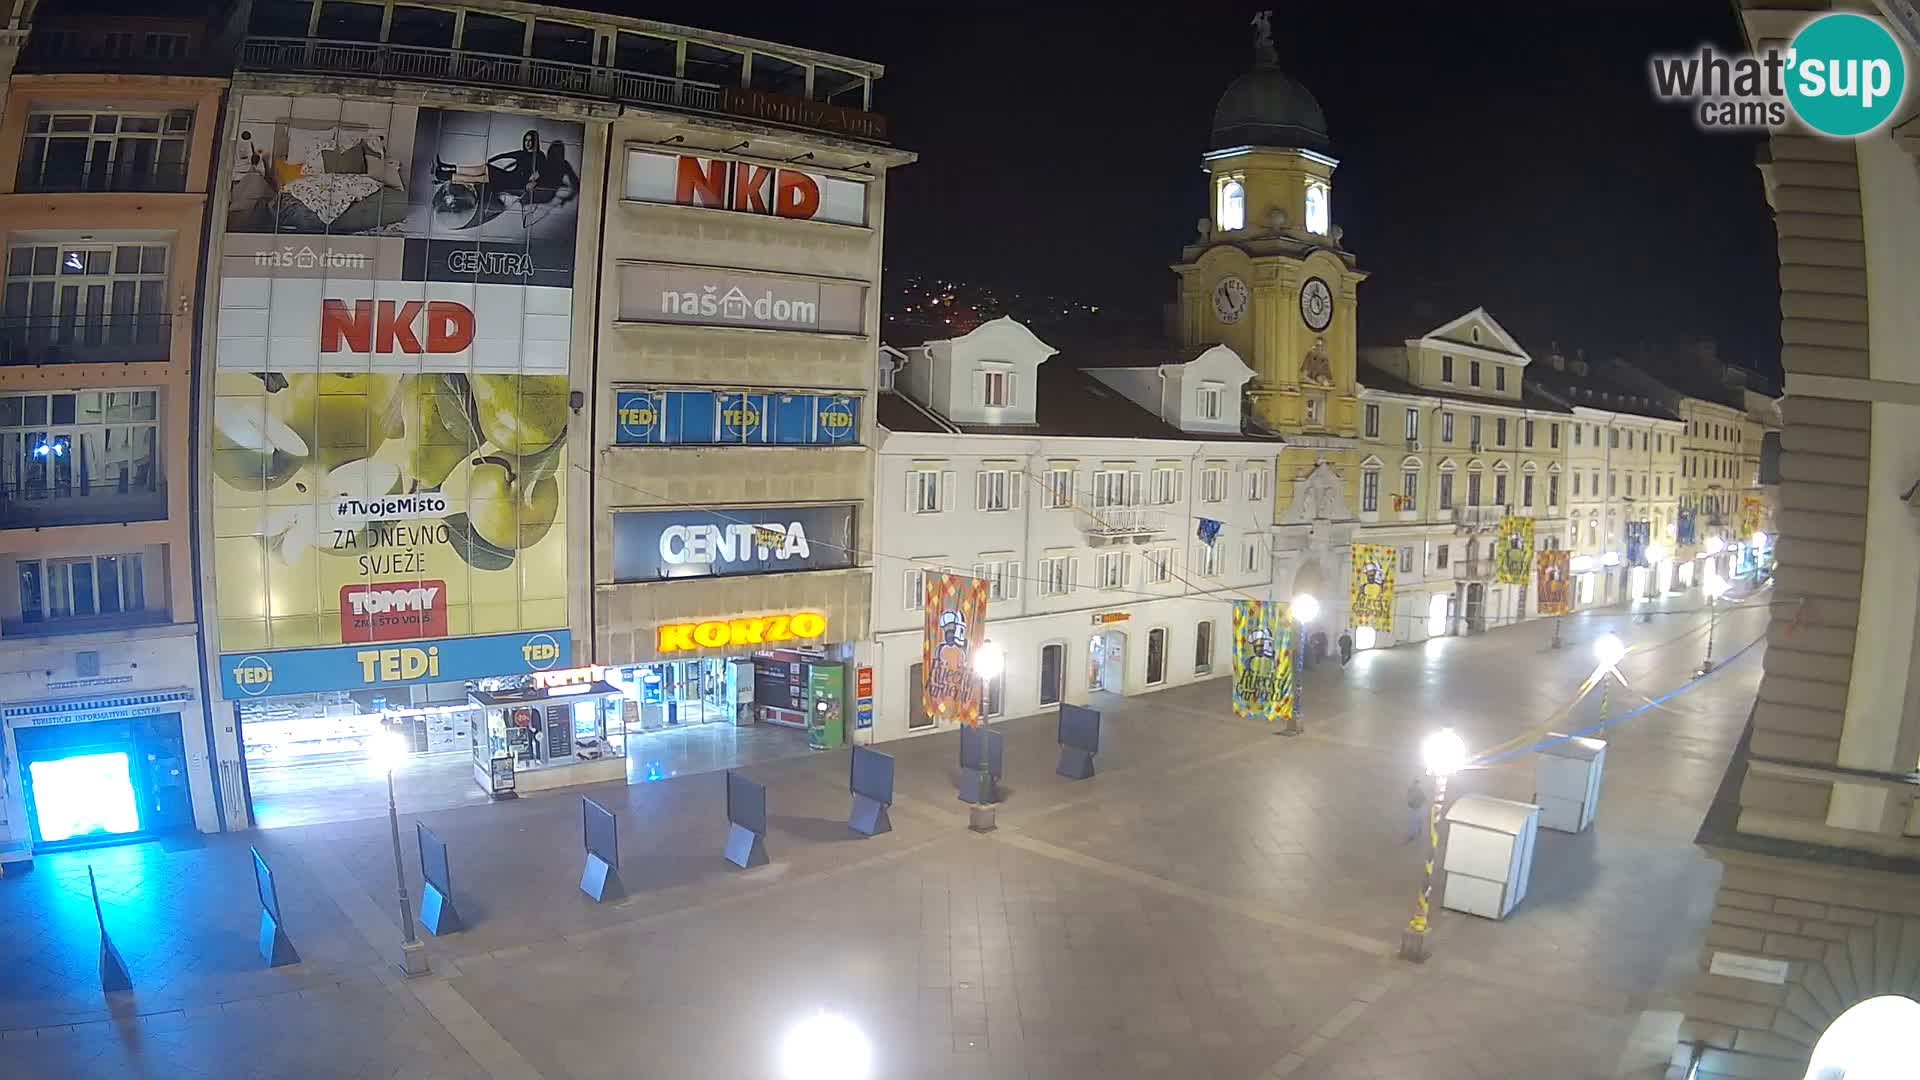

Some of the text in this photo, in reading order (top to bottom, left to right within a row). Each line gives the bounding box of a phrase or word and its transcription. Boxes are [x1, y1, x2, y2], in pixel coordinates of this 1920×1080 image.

[676, 155, 821, 220] NKD
[255, 246, 365, 269] naš dom
[447, 250, 535, 276] CENTRA
[661, 284, 816, 324] naš dom
[320, 299, 477, 354] NKD
[618, 409, 657, 425] TEDi
[723, 410, 760, 426] TEDi
[820, 412, 853, 428] TEDi
[337, 497, 446, 517] #TvojeMisto
[333, 524, 450, 550] ZA DNEVNO
[359, 547, 425, 576] SVJEŽE
[347, 587, 440, 615] TOMMY
[656, 612, 826, 652] KORZO
[357, 647, 440, 684] TEDi
[522, 643, 560, 663] TEDi
[233, 667, 272, 685] TEDi
